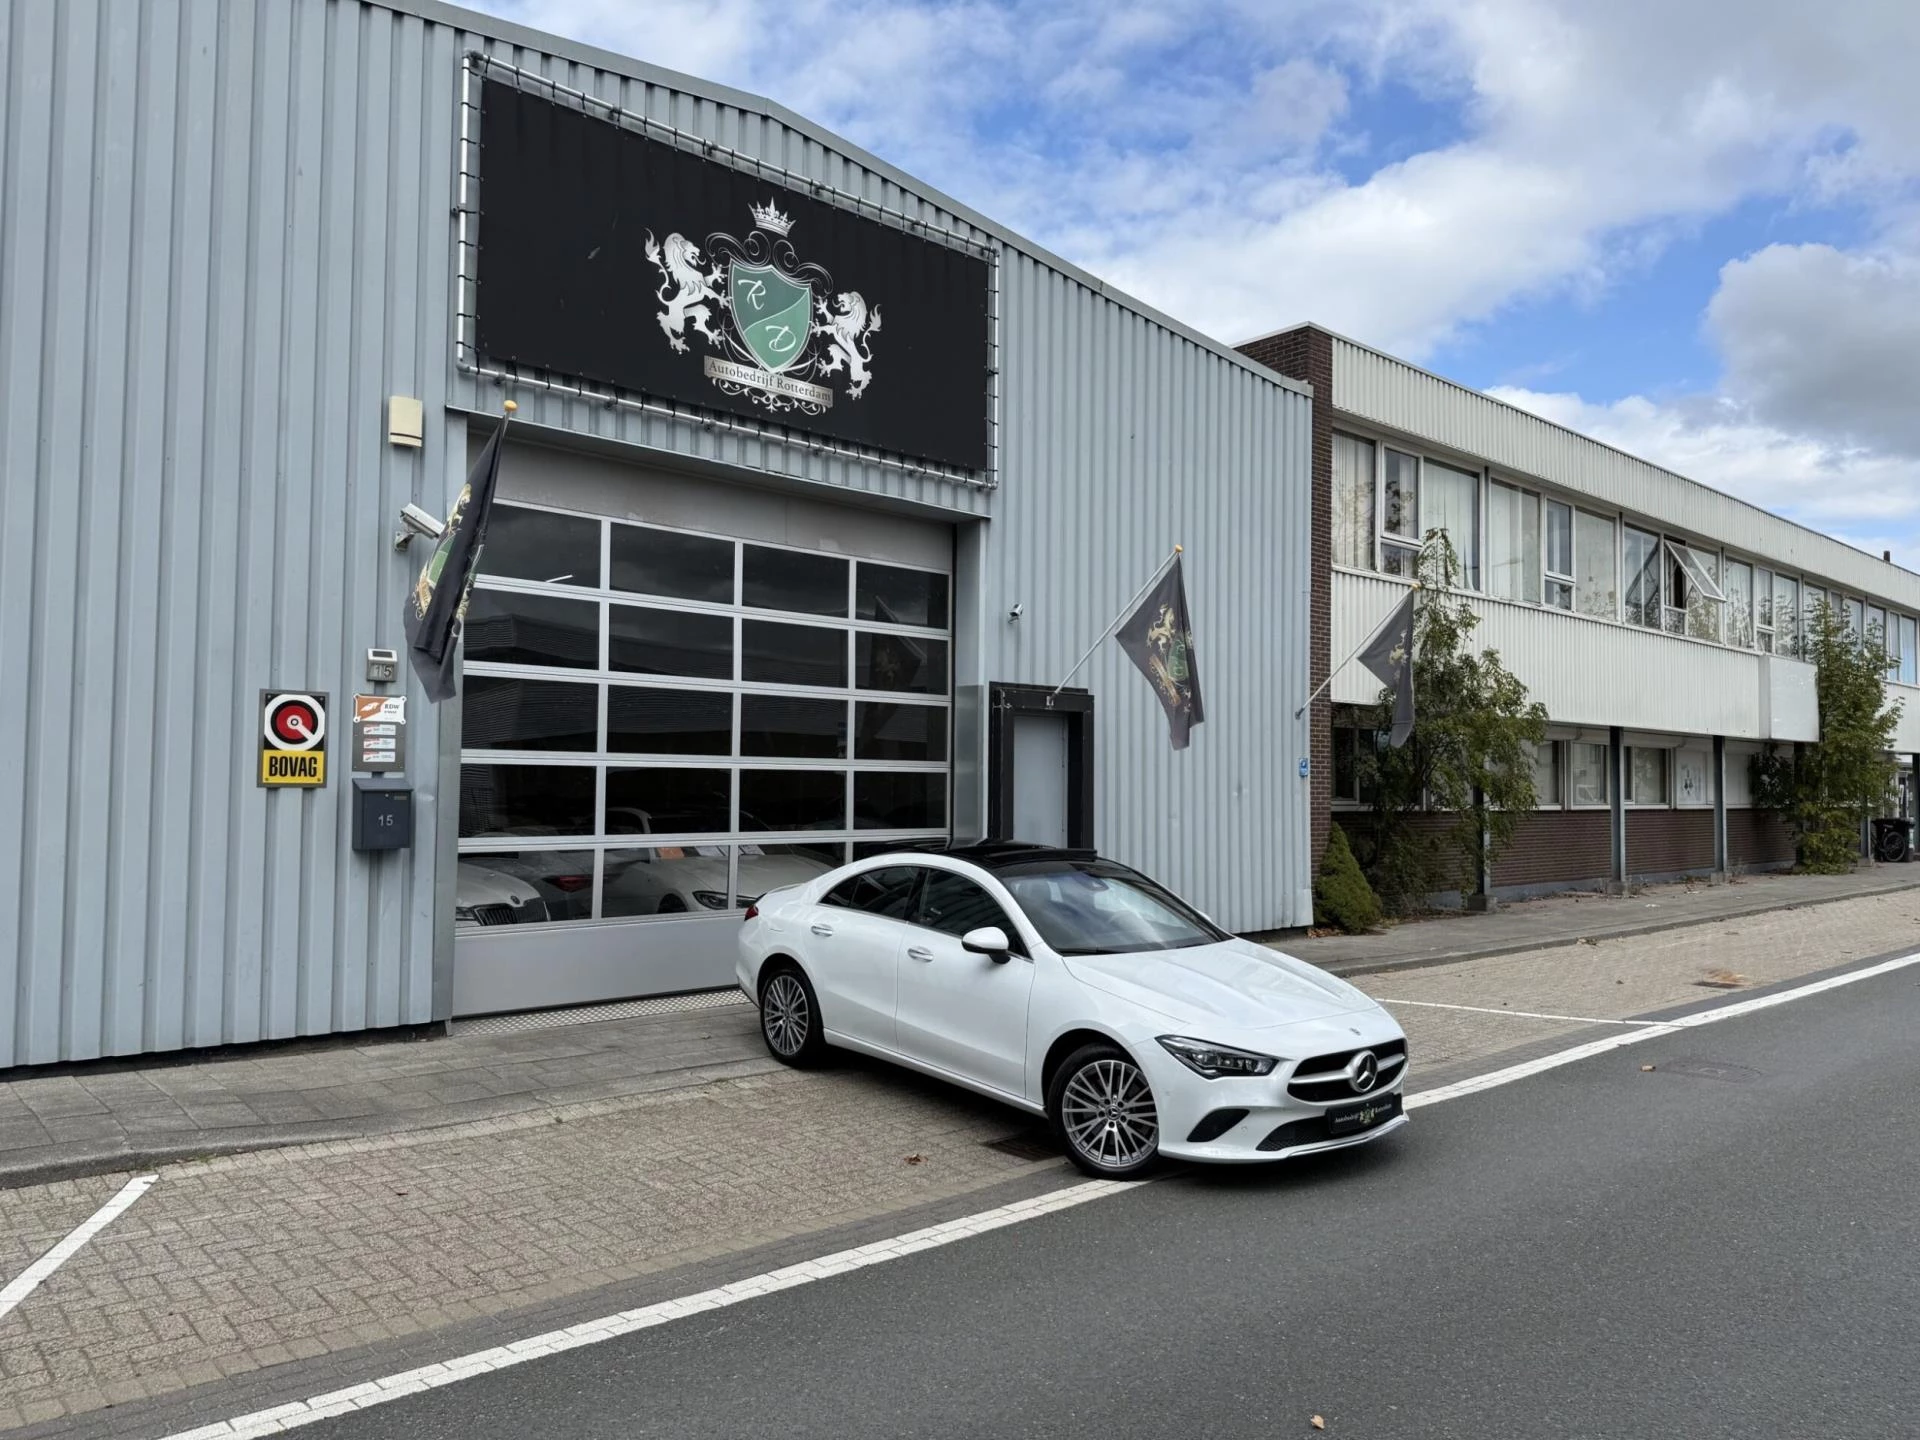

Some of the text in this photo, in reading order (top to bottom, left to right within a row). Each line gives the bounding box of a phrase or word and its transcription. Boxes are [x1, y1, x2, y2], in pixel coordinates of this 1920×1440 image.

[737, 279, 766, 310] R
[709, 360, 831, 400] Autobedrijf Rotterdam
[374, 664, 392, 678] 15
[268, 755, 318, 778] BOVAG
[378, 814, 393, 826] 15
